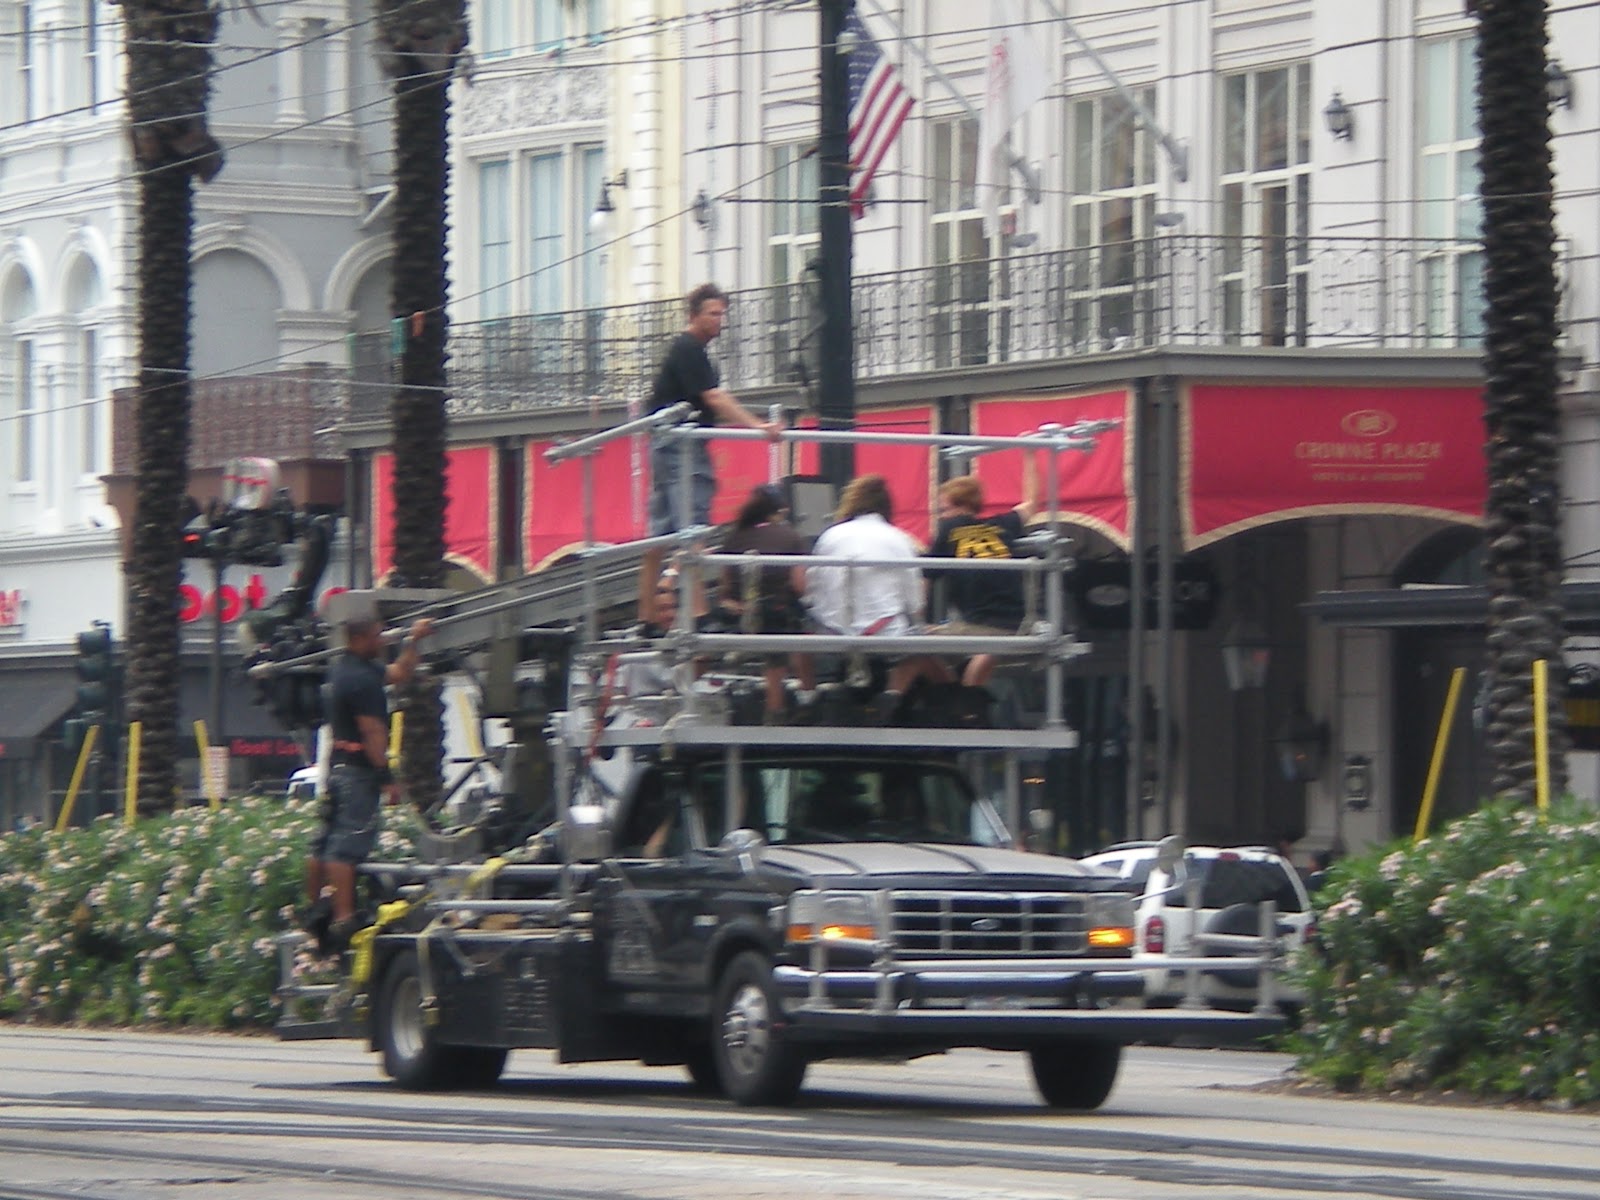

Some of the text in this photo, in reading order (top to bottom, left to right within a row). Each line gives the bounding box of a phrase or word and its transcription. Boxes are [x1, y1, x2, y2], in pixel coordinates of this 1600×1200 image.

[1295, 441, 1442, 459] CROWNE PLAZA
[178, 574, 268, 623] oot
